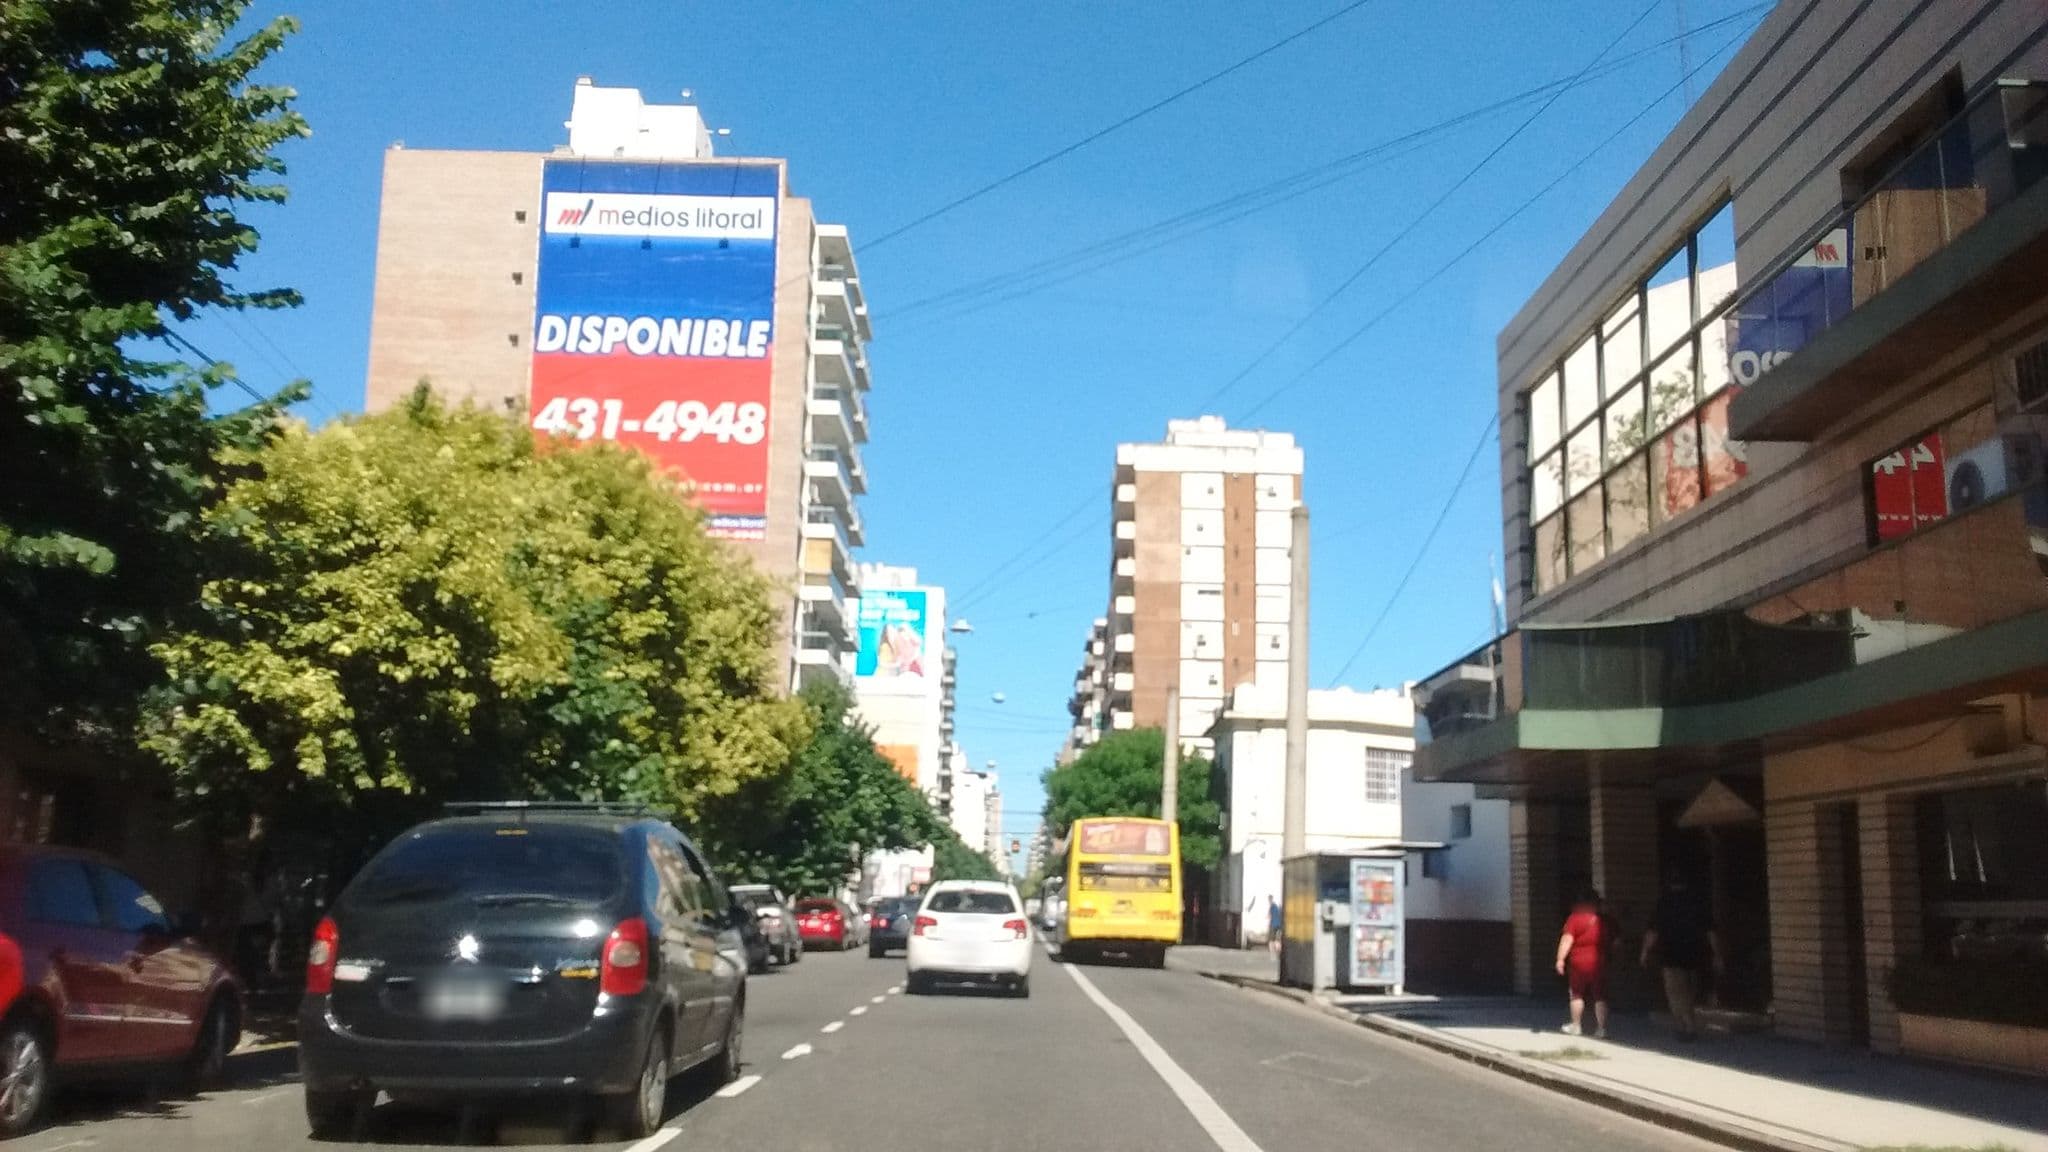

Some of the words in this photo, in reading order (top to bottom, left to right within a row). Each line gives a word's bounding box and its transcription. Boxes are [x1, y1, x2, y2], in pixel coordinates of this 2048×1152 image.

[599, 206, 689, 227] medios
[696, 208, 762, 229] litoral
[536, 315, 770, 358] DISPONIBLE
[533, 397, 767, 445] 431-4948
